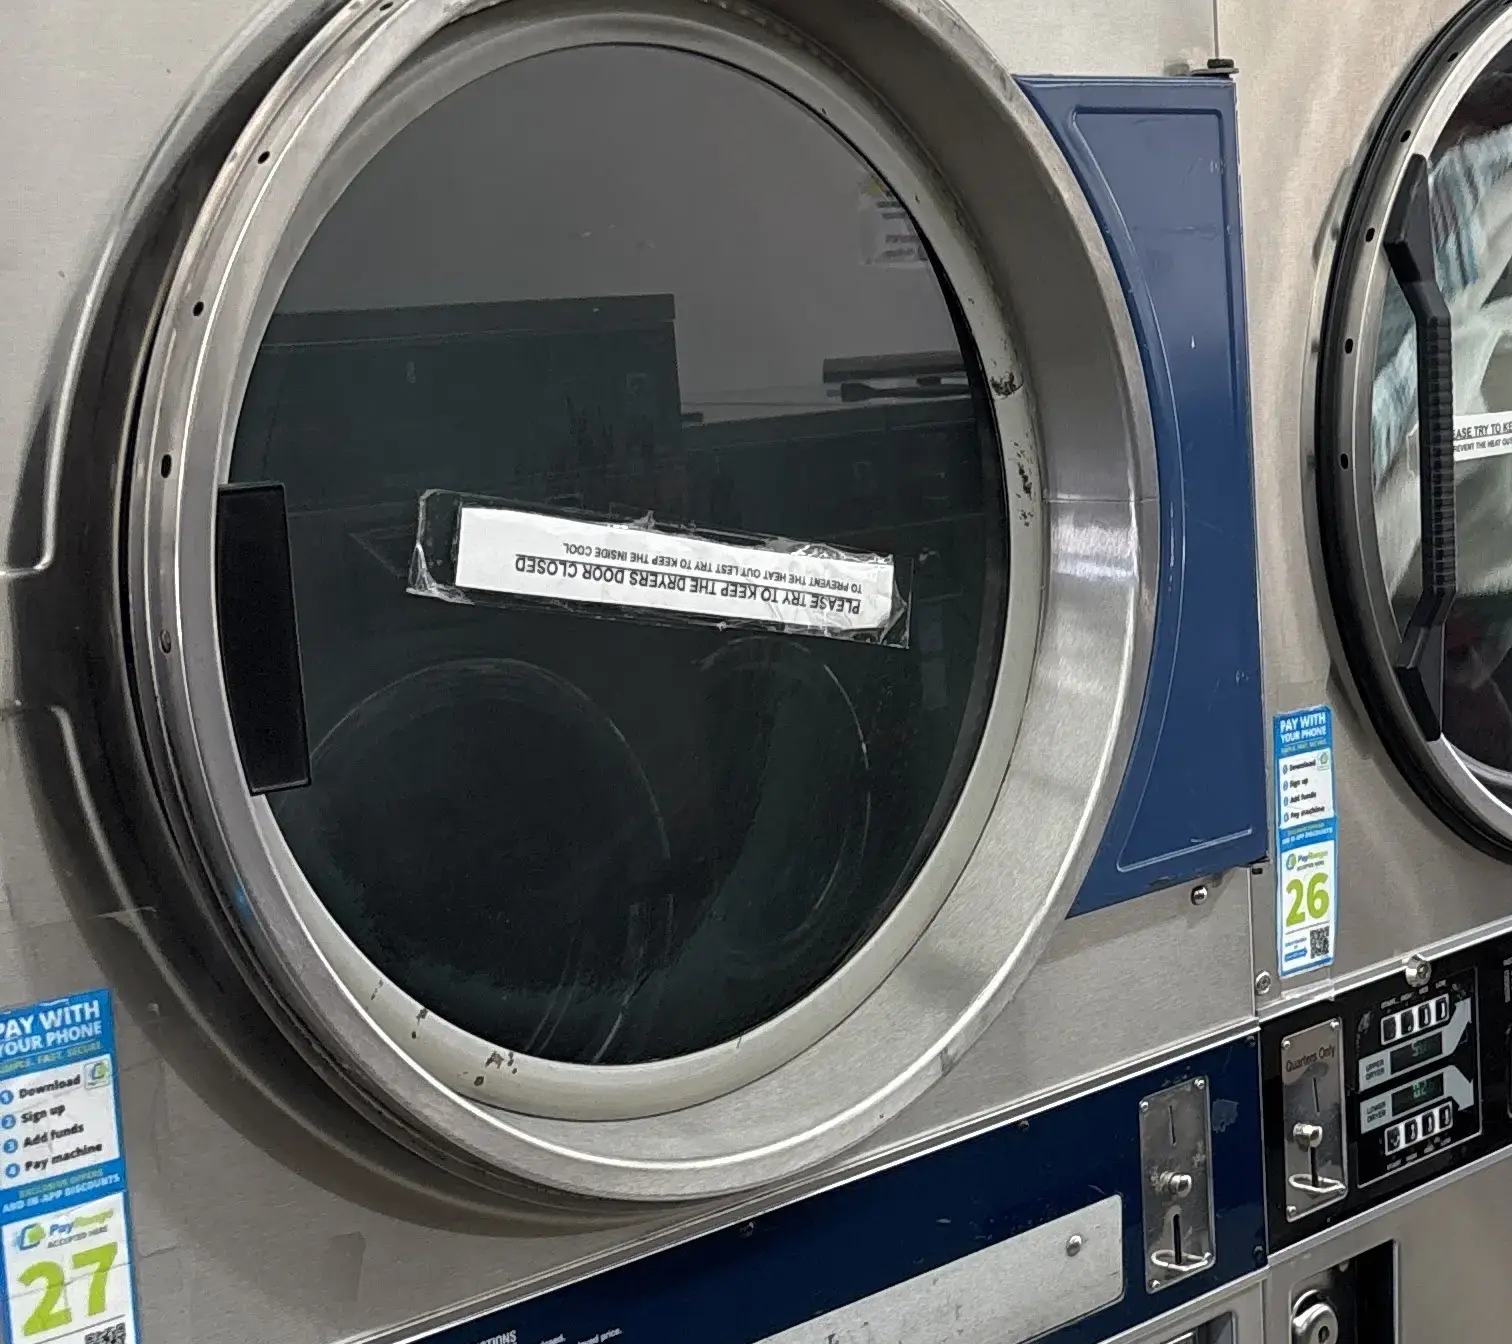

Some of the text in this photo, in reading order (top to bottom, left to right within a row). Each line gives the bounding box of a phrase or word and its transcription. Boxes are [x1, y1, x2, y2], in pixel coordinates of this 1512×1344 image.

[1474, 423, 1489, 437] TRY
[1491, 422, 1501, 435] TO
[563, 542, 863, 594] TO PREVENT THE HEAT OUT LEST TRY TO KEEP THE INSIDE COOL
[515, 556, 861, 615] PLEASE TRY TO KEEP THE DRYERS DOOR CLOSED
[1280, 712, 1326, 734] PAY WITH
[1285, 872, 1330, 927] 26
[39, 999, 100, 1031] WITH
[46, 1020, 102, 1047] PHONE
[1286, 1044, 1335, 1073] Quarters Only
[19, 1074, 81, 1099] Download
[21, 1104, 66, 1124] Sign up
[23, 1123, 84, 1148] Add funds
[25, 1143, 102, 1172] Pay machine
[17, 1241, 118, 1337] 27
